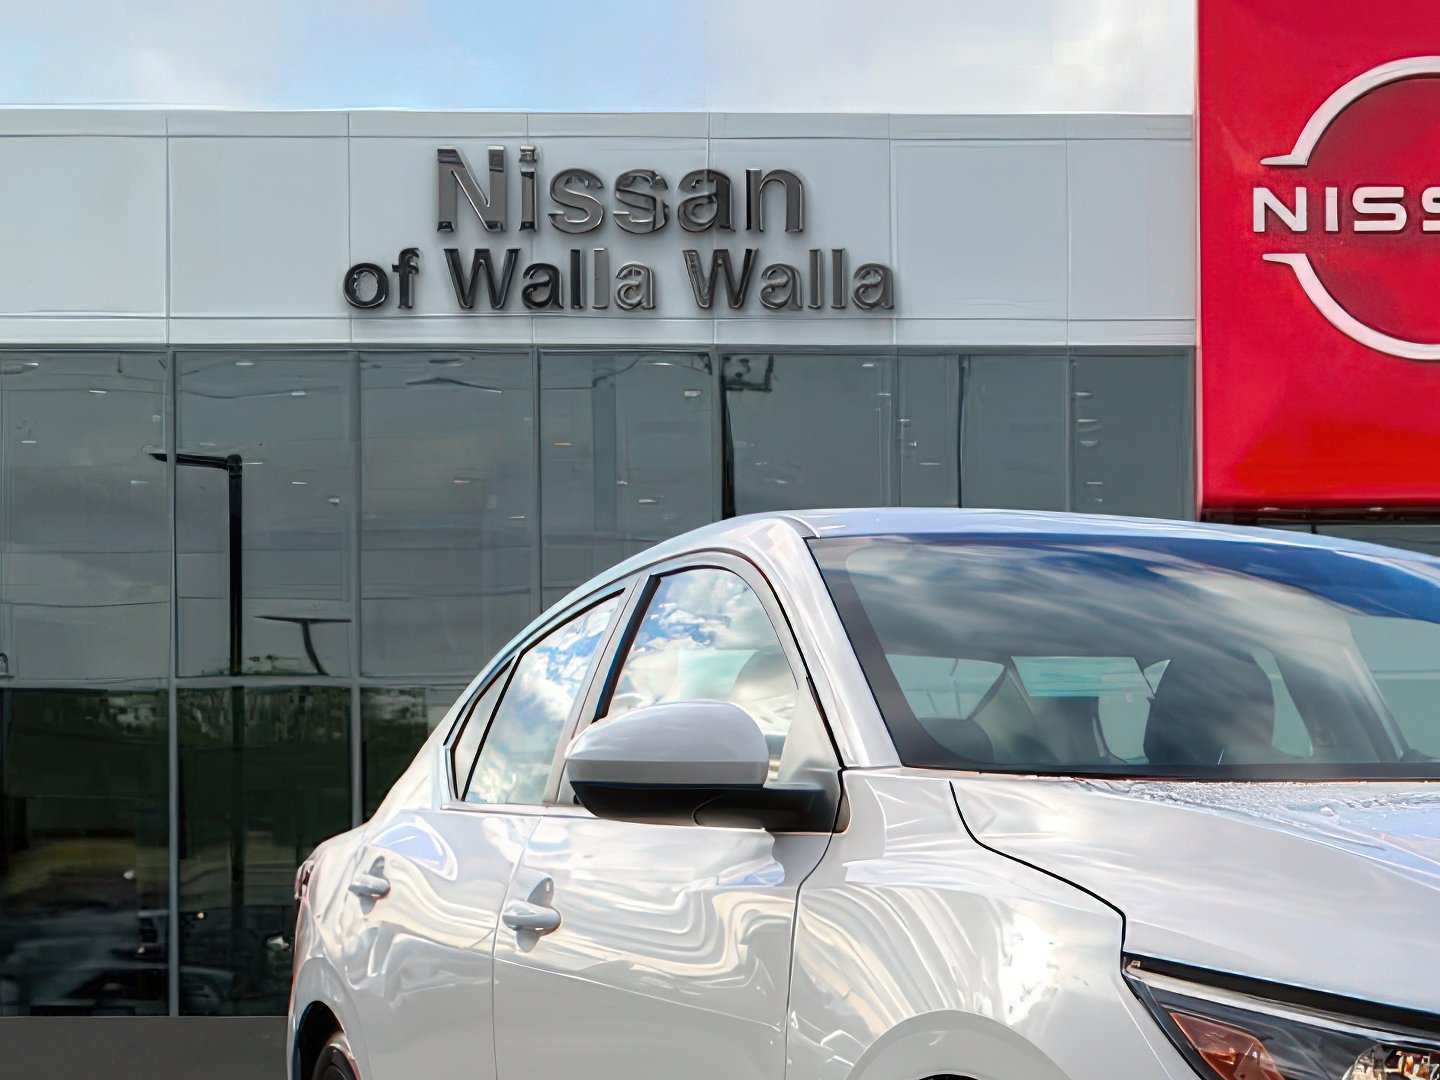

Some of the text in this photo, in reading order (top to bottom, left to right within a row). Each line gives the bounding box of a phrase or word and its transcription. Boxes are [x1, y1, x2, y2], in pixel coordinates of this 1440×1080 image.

[437, 145, 804, 233] Nissan
[344, 247, 895, 310] of Walla Walla
